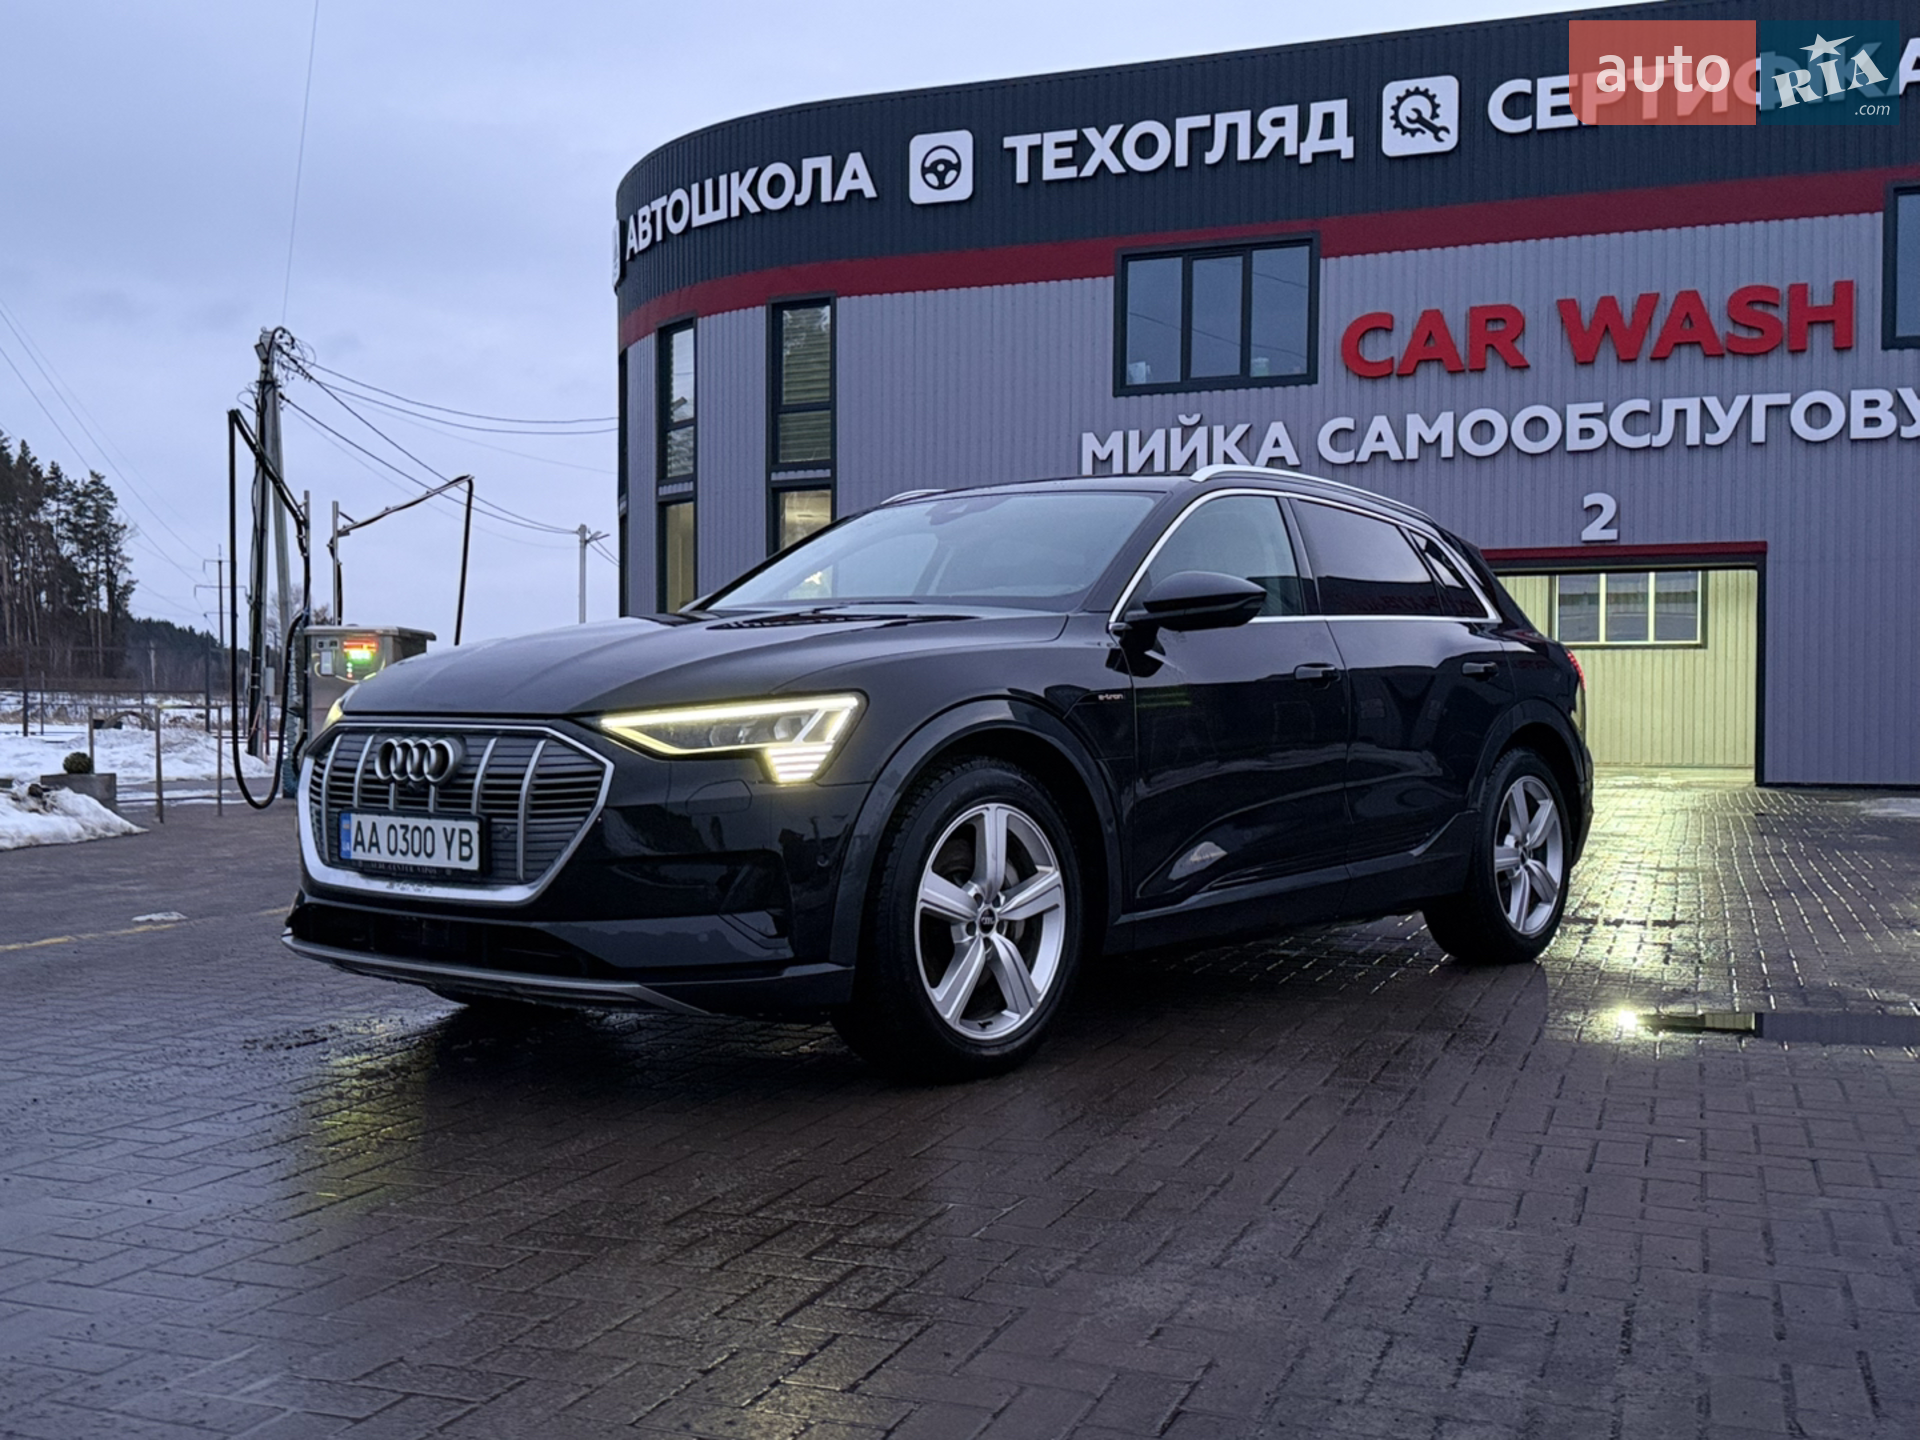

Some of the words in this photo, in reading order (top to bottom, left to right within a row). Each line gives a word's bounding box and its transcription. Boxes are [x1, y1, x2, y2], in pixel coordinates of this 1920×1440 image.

[626, 152, 878, 261] АВТОШКОЛА
[1003, 99, 1354, 184] ТЕХОГЛЯД
[1341, 303, 1530, 378] CAR
[1557, 280, 1853, 364] WASH
[1081, 414, 1300, 475] МИЙКА
[1581, 492, 1618, 541] 2
[353, 820, 381, 854] AA
[387, 823, 435, 859] 0300
[442, 826, 474, 862] YB
